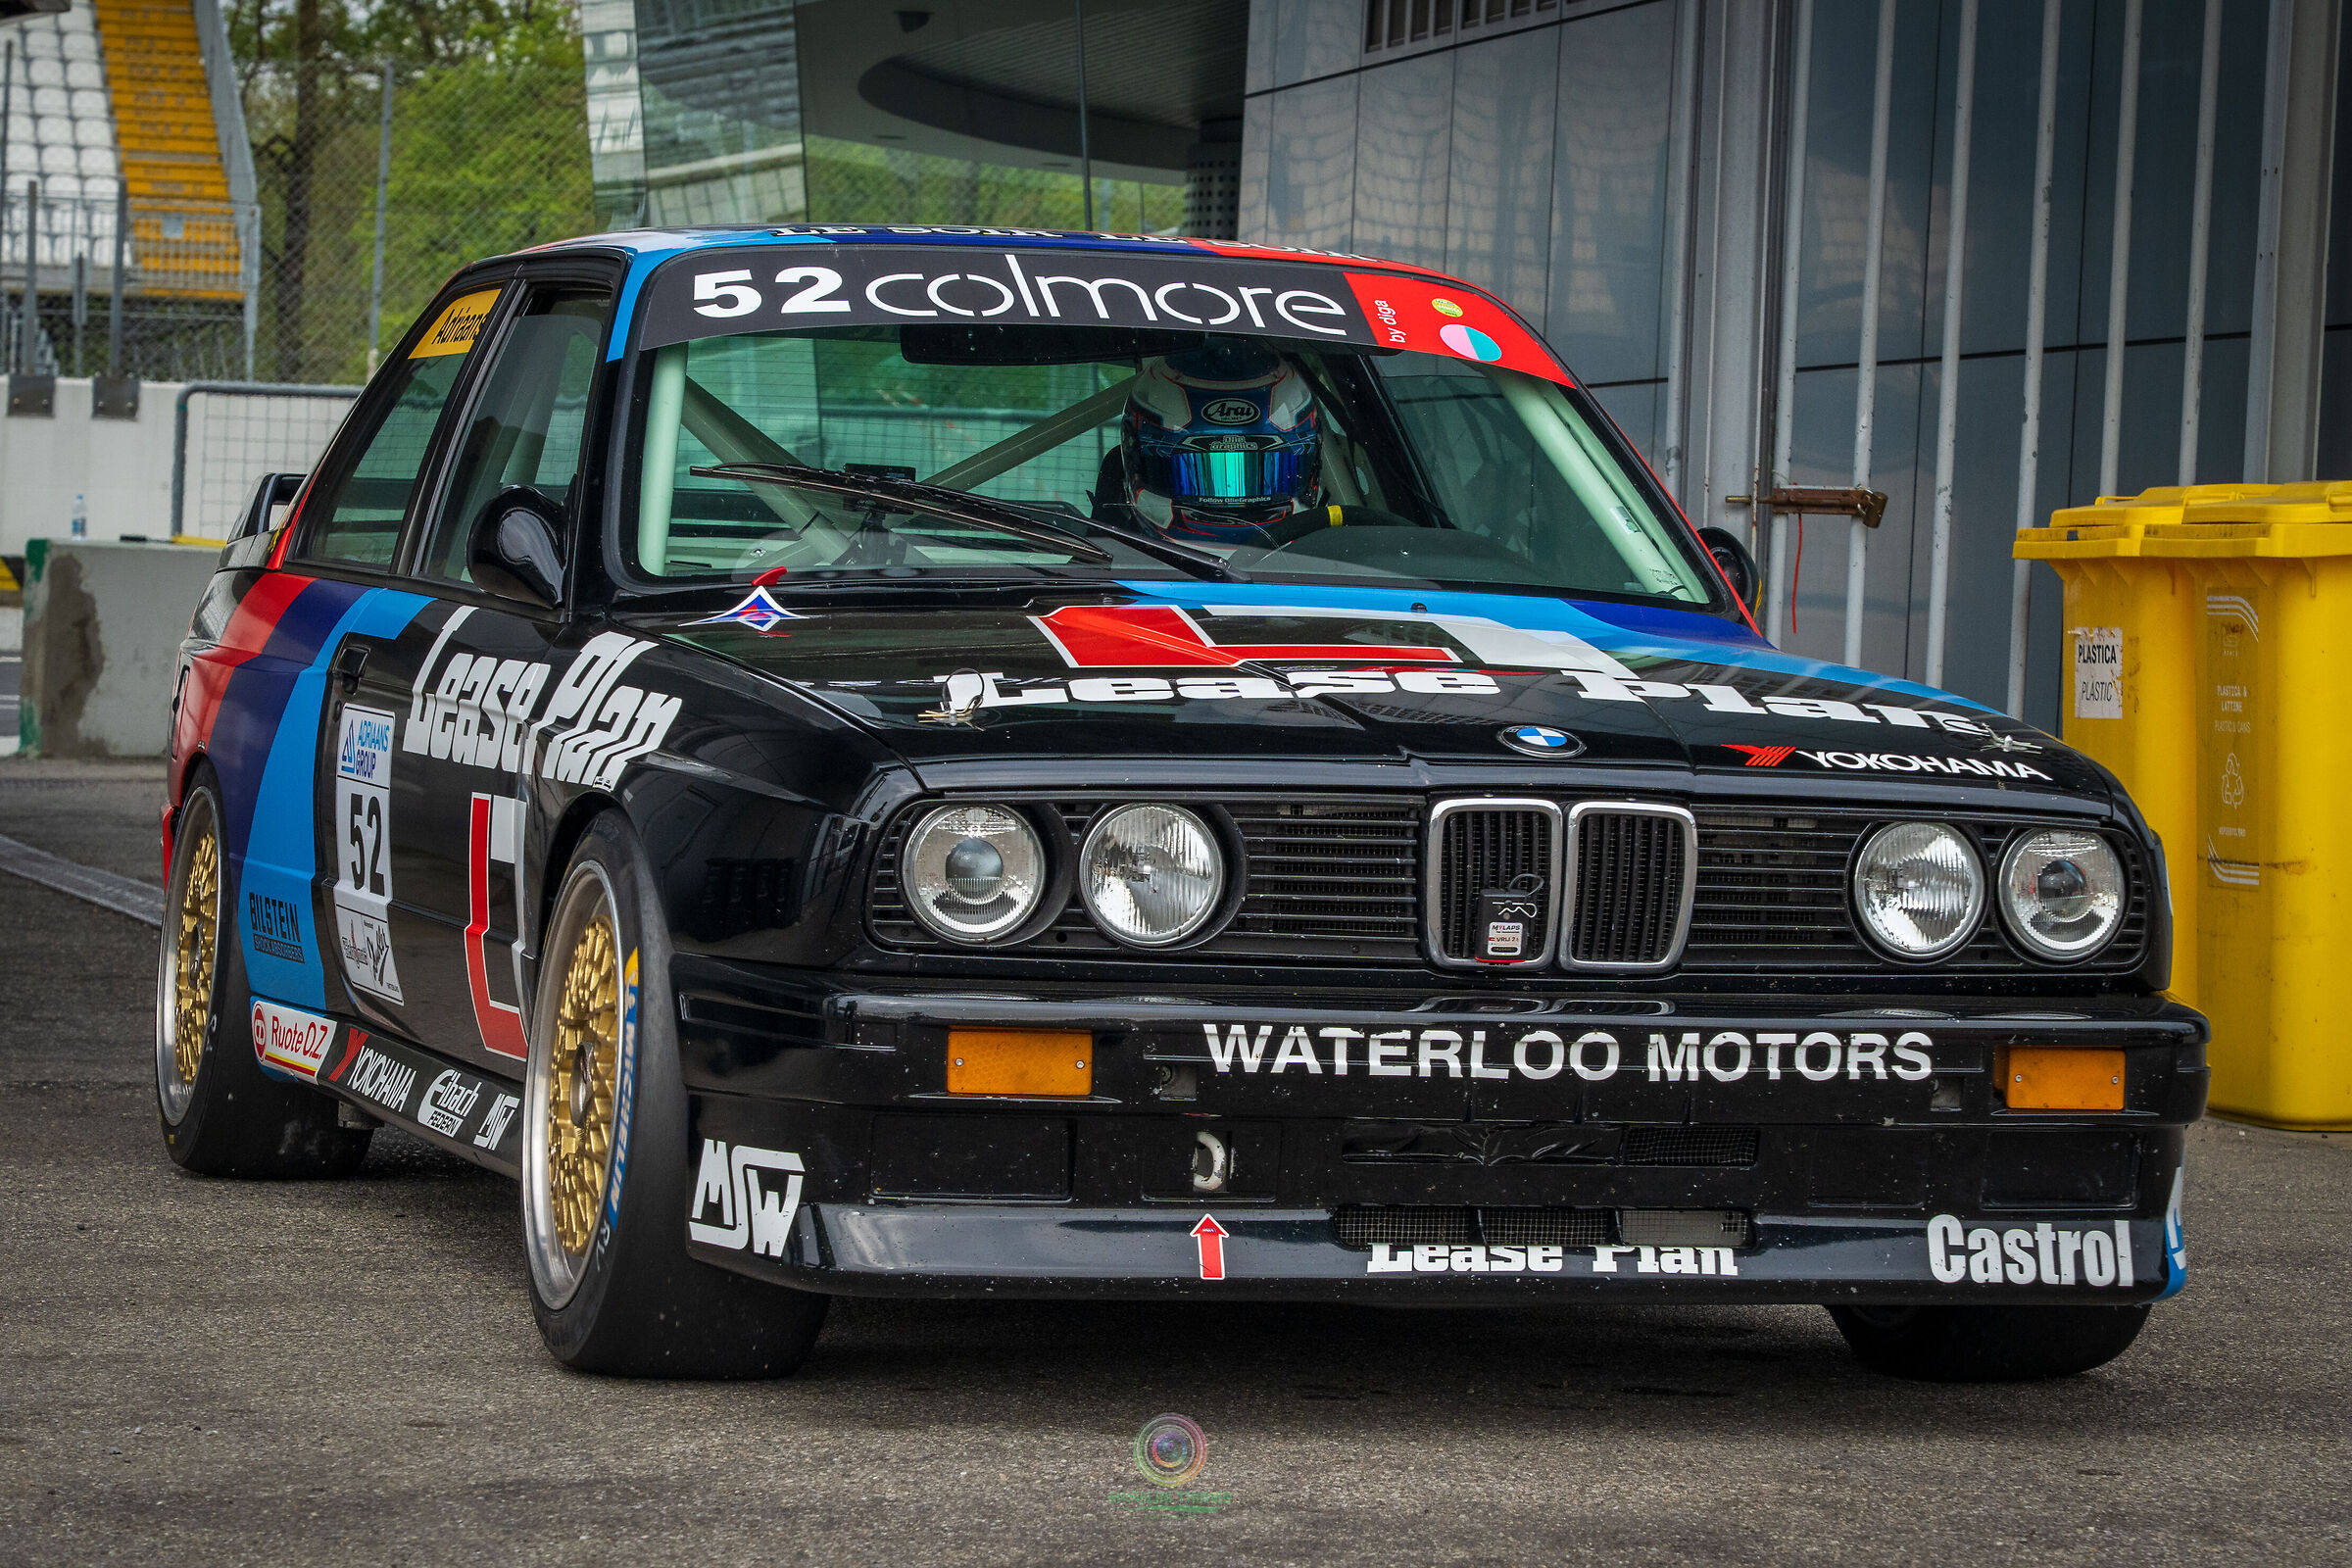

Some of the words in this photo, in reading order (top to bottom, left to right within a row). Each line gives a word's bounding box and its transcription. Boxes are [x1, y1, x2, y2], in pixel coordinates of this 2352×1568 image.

[693, 266, 851, 318] 52
[865, 254, 1348, 336] colmore
[1375, 299, 1397, 325] diga
[1389, 324, 1405, 343] by
[1207, 402, 1252, 417] Arai
[1211, 442, 1257, 451] Graphics
[2078, 644, 2117, 664] PLASTICA
[403, 605, 551, 774] Lease
[522, 631, 683, 791] Plan
[933, 670, 1501, 709] Lease
[1560, 669, 1993, 736] Plan
[2082, 681, 2113, 702] PLASTIC
[2217, 684, 2241, 697] PLASTICA
[2221, 700, 2243, 712] LATTINE
[357, 719, 390, 752] ADRIAANS
[356, 749, 376, 779] GROUP
[1795, 750, 2054, 781] YOKOHAMA
[350, 793, 385, 897] 52
[249, 892, 301, 943] BILSTEIN
[271, 1015, 304, 1053] Ruote
[1202, 1023, 1621, 1079] WATERLOO
[1647, 1032, 1934, 1082] MOTORS
[347, 1045, 417, 1113] YOKOHAMA
[417, 1069, 482, 1120] Eibach
[427, 1111, 459, 1135] FEDERN
[610, 1024, 636, 1212] MICHELIN
[689, 1138, 807, 1257] MSW
[1927, 1214, 2134, 1287] Castrol
